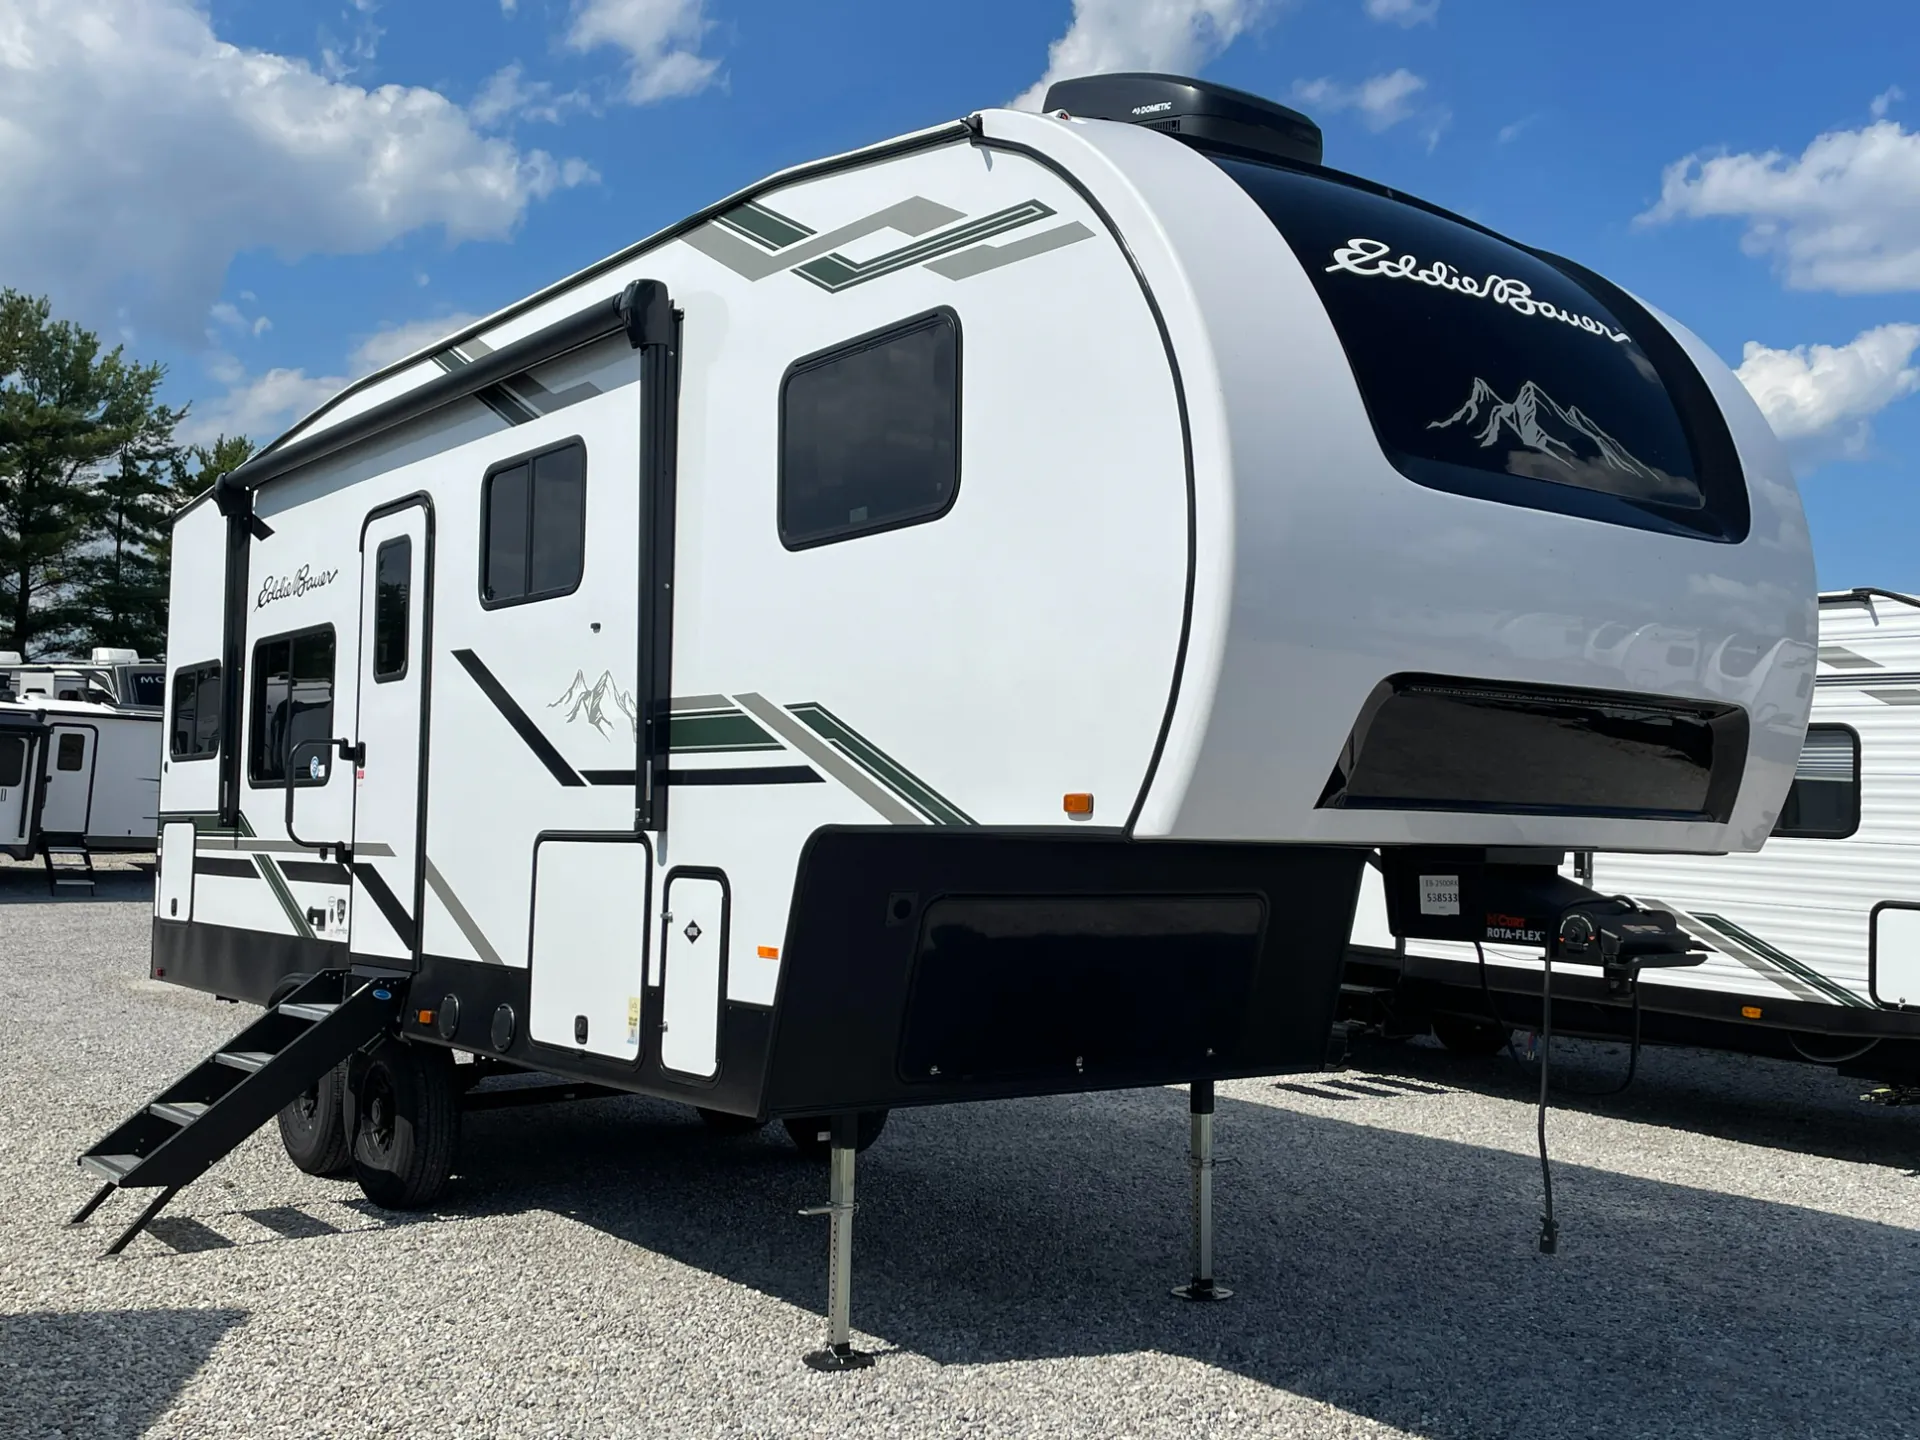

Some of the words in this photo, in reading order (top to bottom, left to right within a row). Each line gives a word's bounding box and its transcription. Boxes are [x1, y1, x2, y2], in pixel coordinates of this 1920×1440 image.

[1140, 101, 1172, 115] DOMETIC
[1325, 238, 1486, 297] Eddie
[1483, 275, 1632, 343] Bauer
[253, 575, 293, 613] Eddie
[292, 563, 339, 598] Bauer
[1426, 892, 1458, 903] 538533
